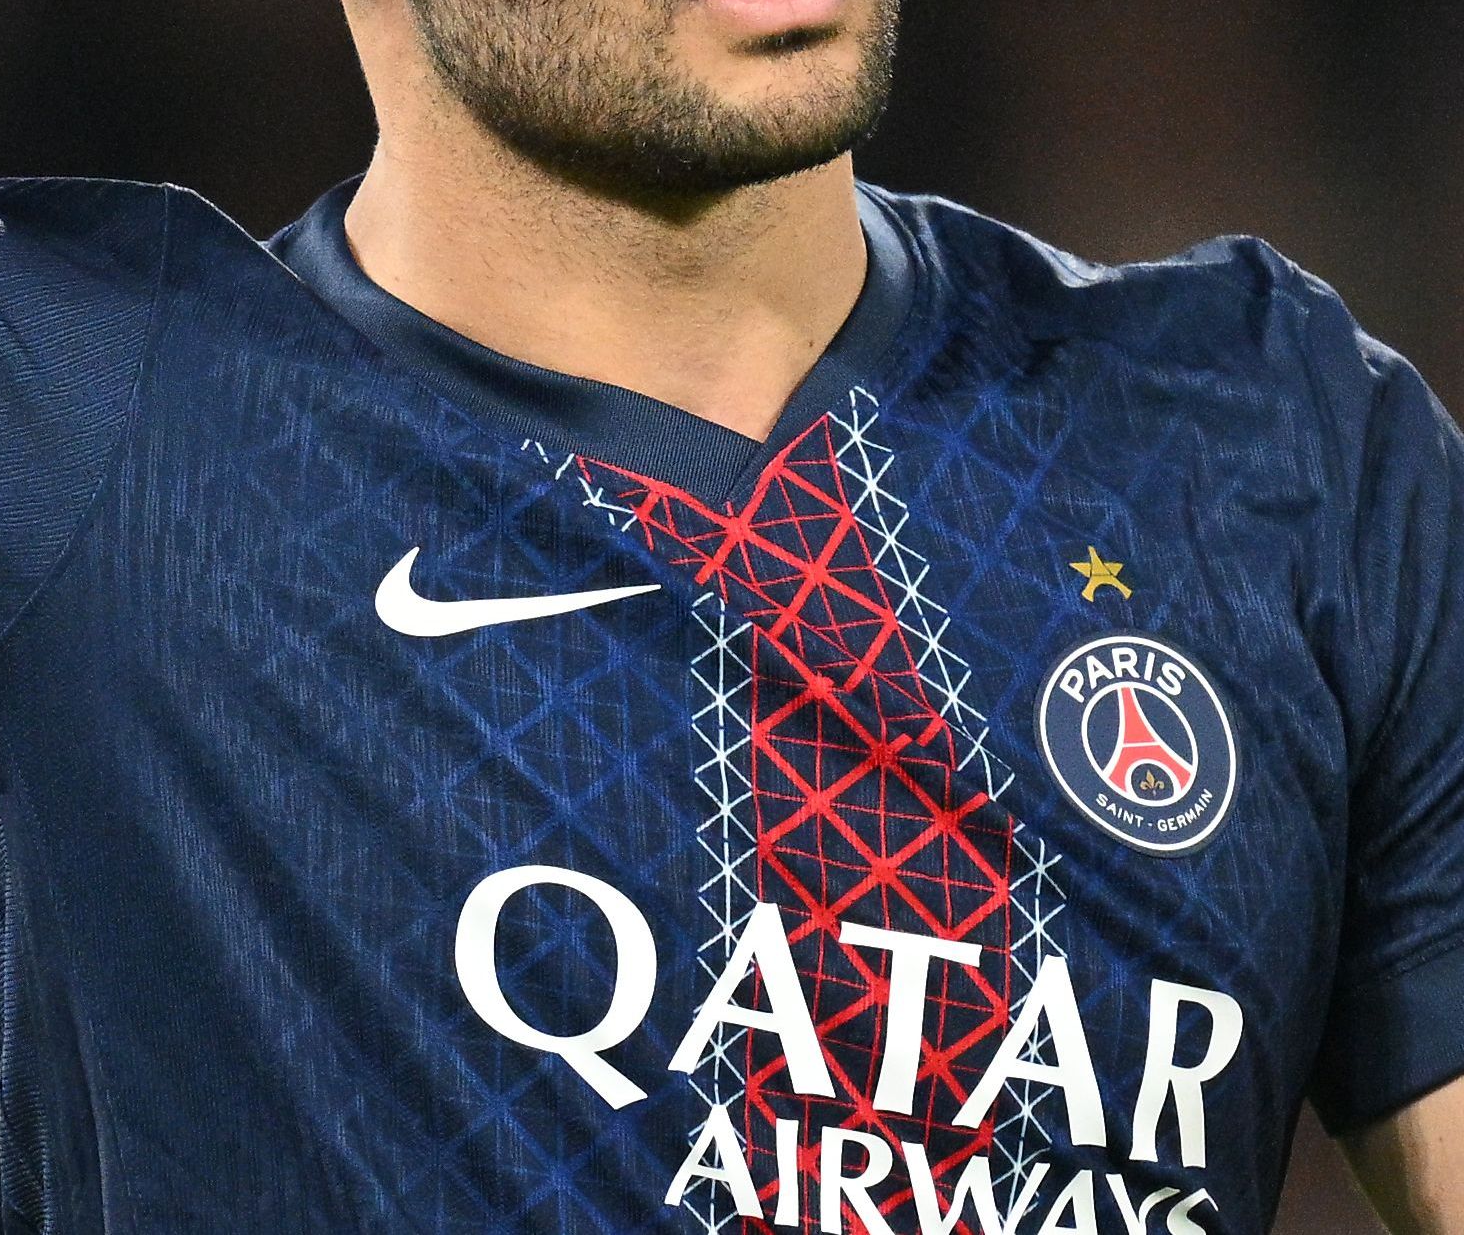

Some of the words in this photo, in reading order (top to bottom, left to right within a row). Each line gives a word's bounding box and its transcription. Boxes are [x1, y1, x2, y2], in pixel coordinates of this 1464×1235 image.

[1058, 646, 1187, 704] PARIS
[1095, 792, 1145, 828] SAINT
[1156, 787, 1214, 833] GERMAIN
[453, 863, 1245, 1169] QATAR
